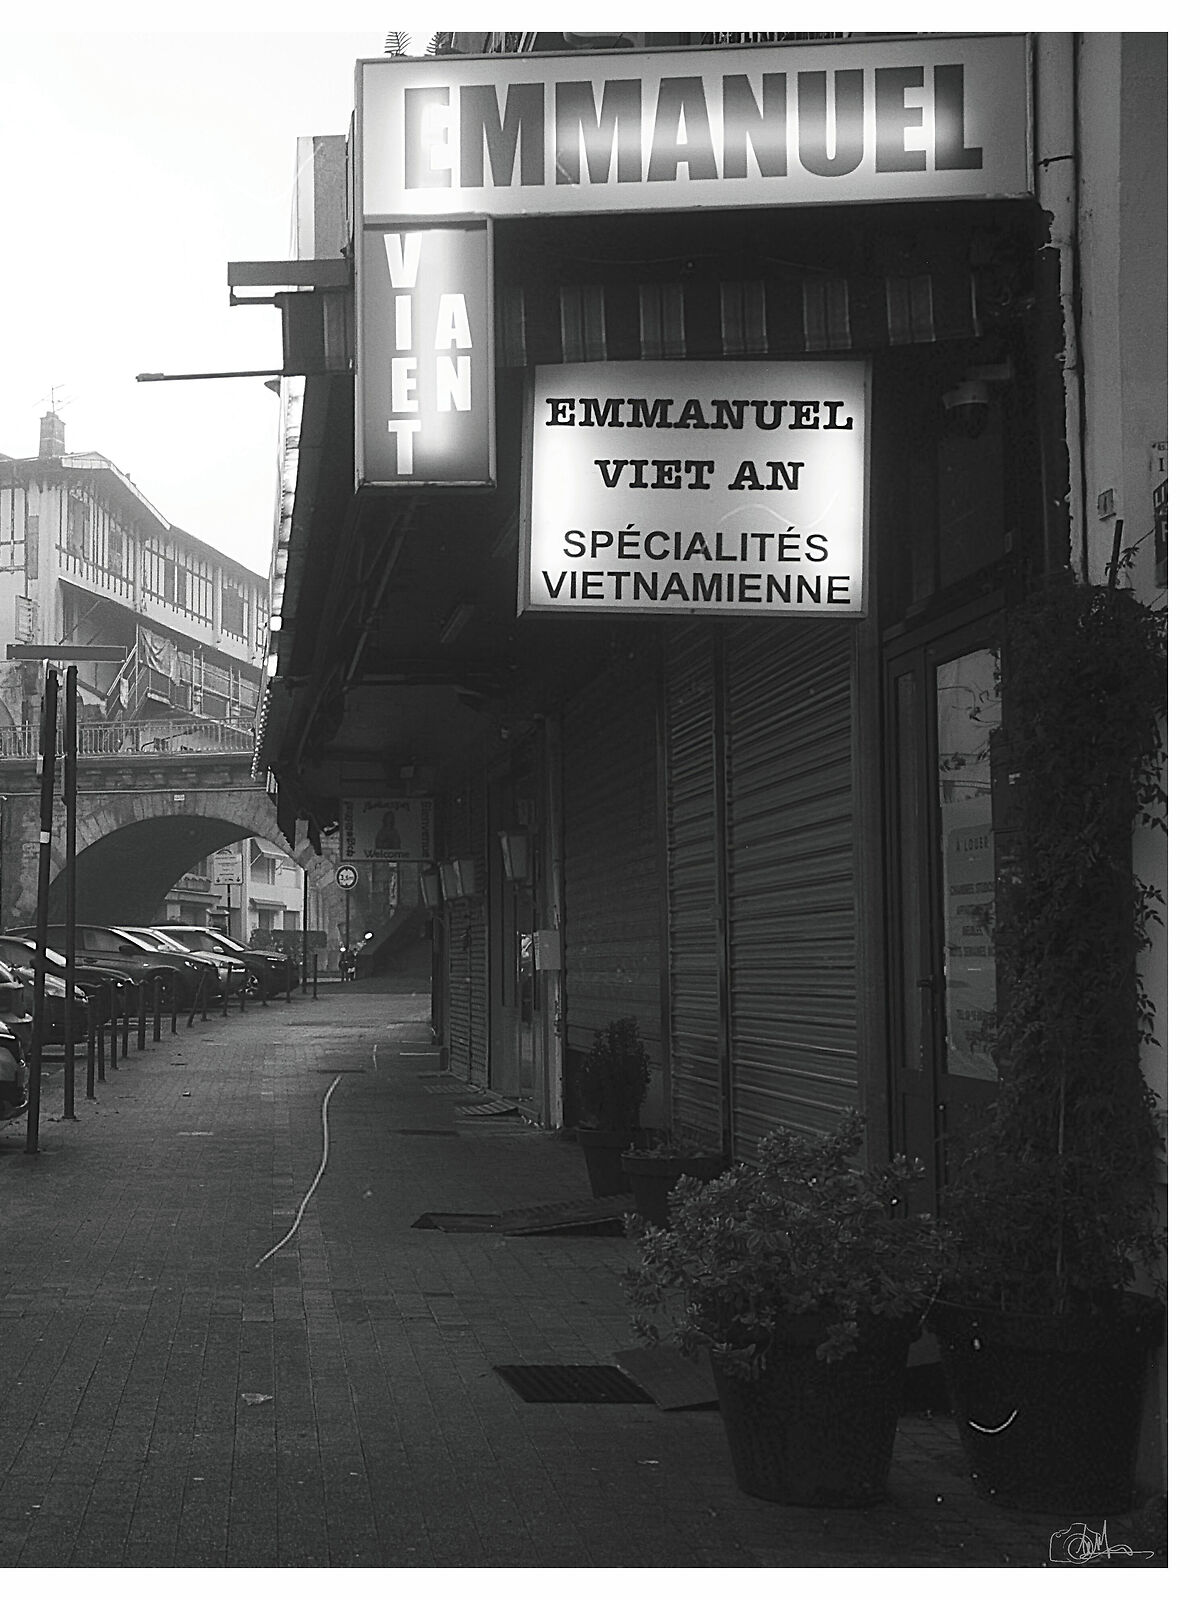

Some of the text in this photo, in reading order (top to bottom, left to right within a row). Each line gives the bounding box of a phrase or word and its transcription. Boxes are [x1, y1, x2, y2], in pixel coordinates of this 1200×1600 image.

[404, 64, 983, 189] EMMANUEL
[383, 232, 422, 475] VIET
[435, 294, 472, 412] AN
[545, 398, 853, 430] EMMANUEL
[594, 460, 805, 490] VIET AN
[563, 524, 829, 562] SPÉCIALITÉS
[542, 570, 851, 604] VIETNAMIENNE
[363, 849, 410, 858] Welcome
